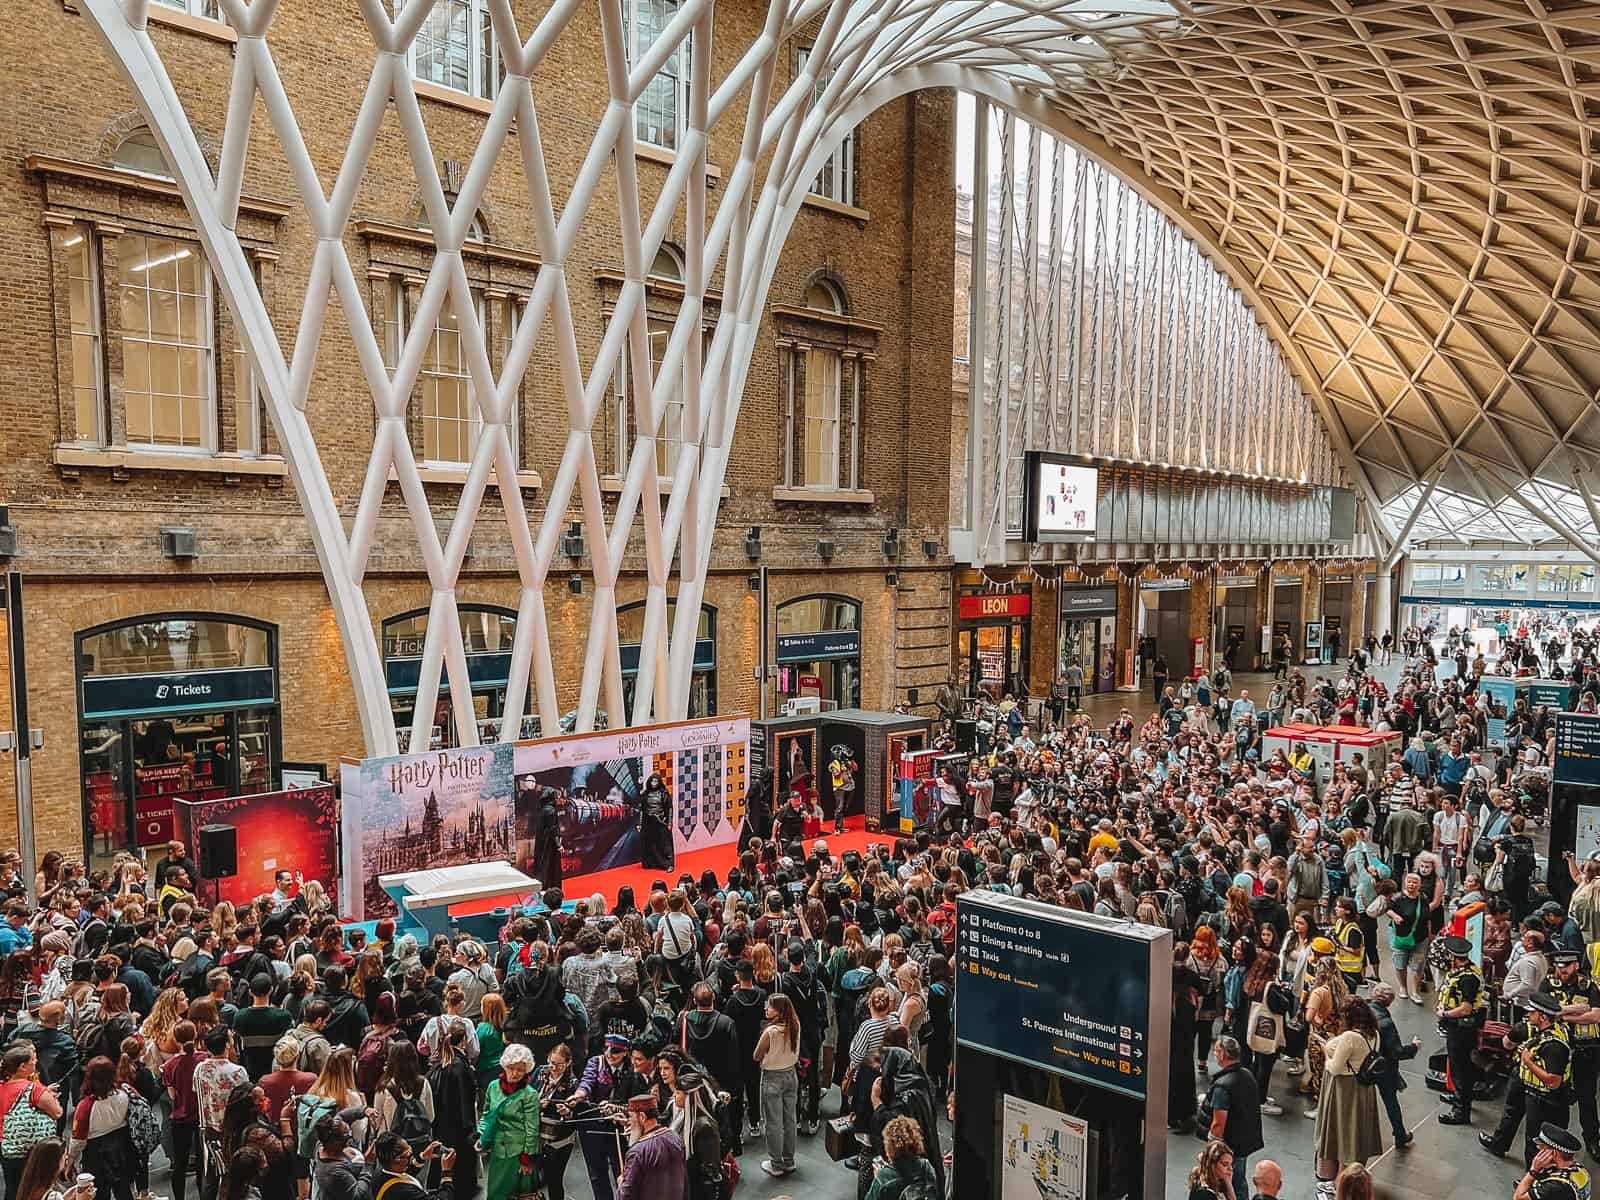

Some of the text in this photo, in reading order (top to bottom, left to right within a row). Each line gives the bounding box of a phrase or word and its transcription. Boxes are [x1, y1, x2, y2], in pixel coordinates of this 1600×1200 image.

[982, 598, 1008, 614] LEON
[172, 683, 212, 696] Tickets
[617, 733, 660, 754] Harry Potter
[387, 761, 436, 794] Harry
[439, 752, 485, 791] Potter
[982, 918, 1041, 939] Platforms 0 to 8
[981, 950, 1000, 962] Taxis
[982, 934, 1043, 958] Dining & seating
[981, 965, 1011, 981] Way out
[1063, 1011, 1117, 1034] Underground
[1022, 1017, 1116, 1051] St. Pancras International
[1082, 1050, 1100, 1064] Way
[1101, 1058, 1116, 1068] out
